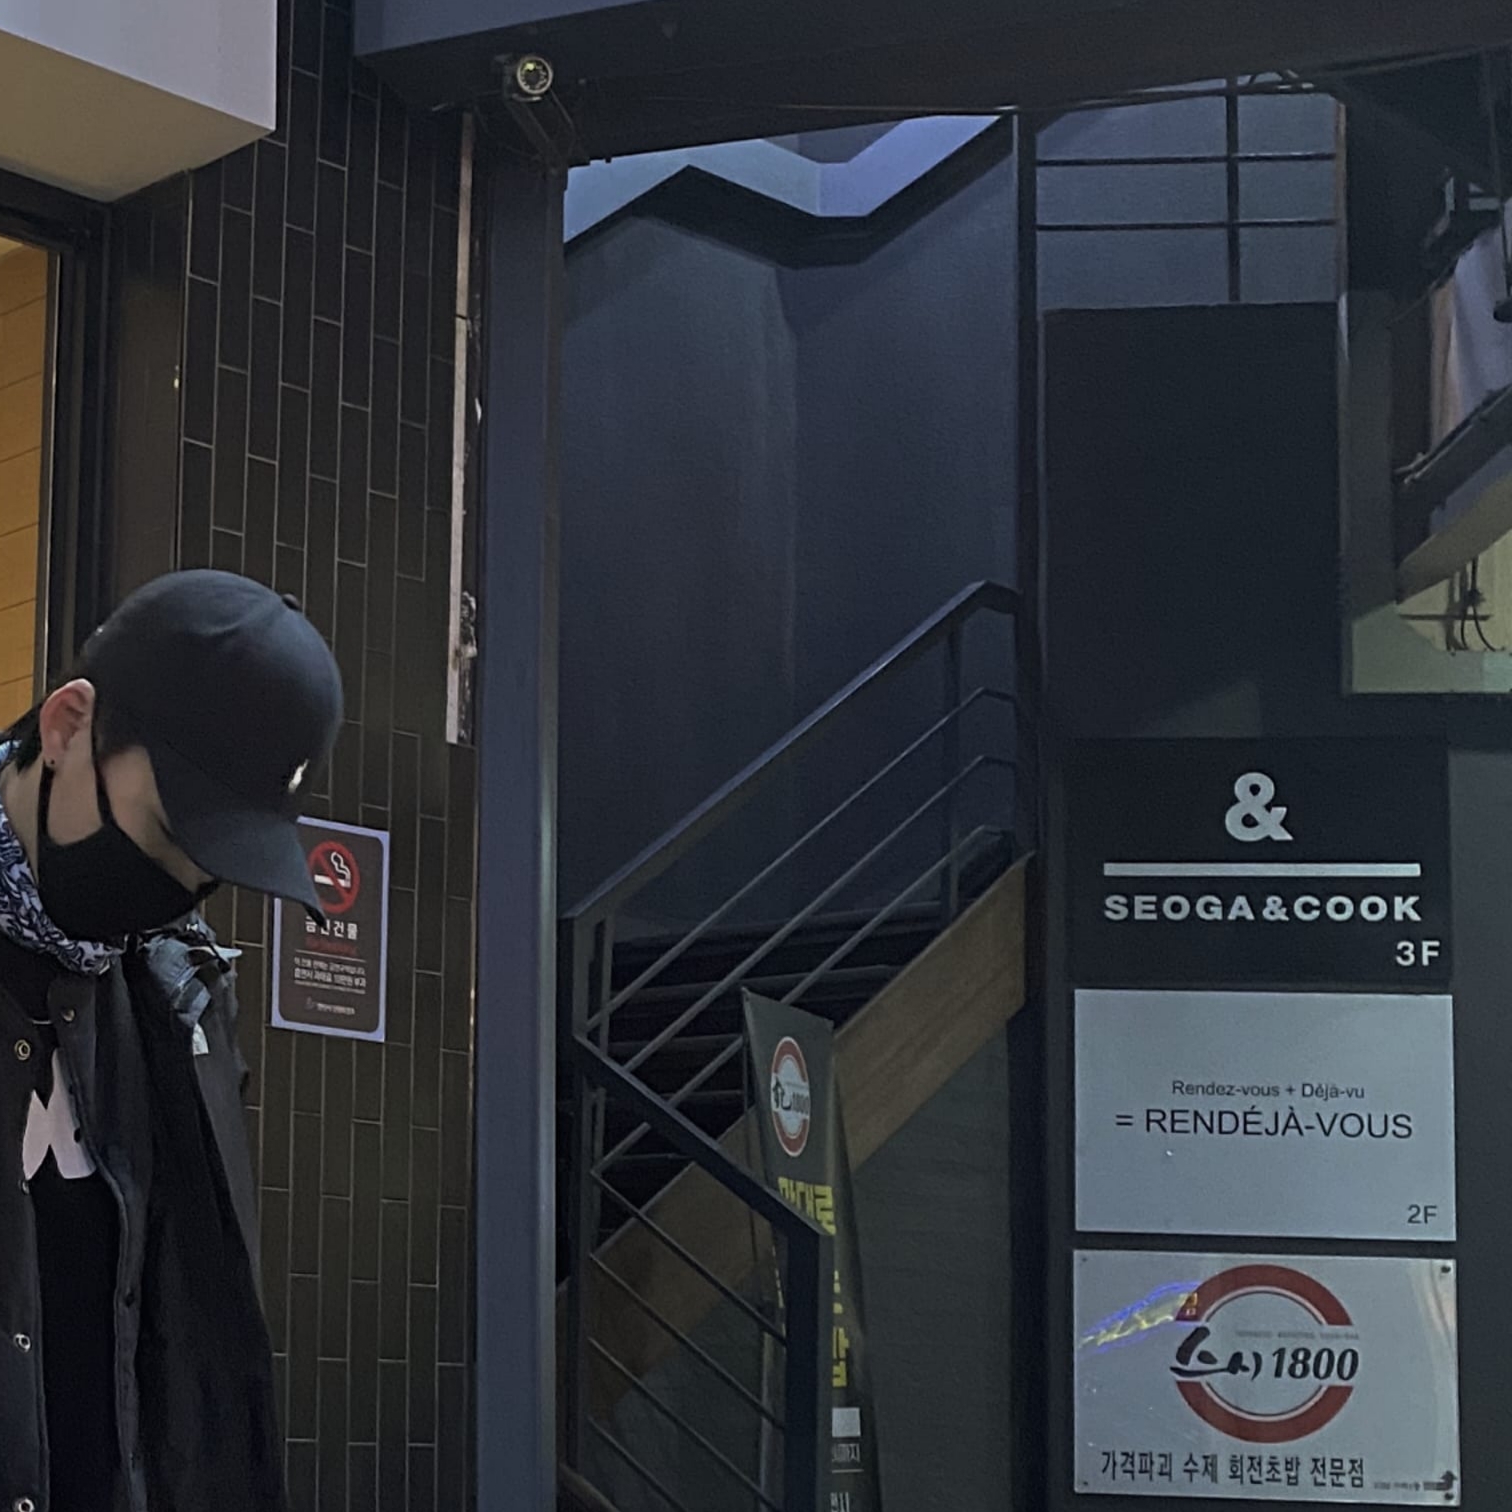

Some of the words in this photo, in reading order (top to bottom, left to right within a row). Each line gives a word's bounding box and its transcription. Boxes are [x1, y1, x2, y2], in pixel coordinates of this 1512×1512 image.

[1103, 894, 1423, 922] SEOGA&COOK
[1395, 941, 1440, 966] 3F
[1172, 1080, 1280, 1099] Rendez-vous
[1301, 1082, 1365, 1102] Déjà-vu
[1145, 1104, 1413, 1140] RENDÉJÀ-VOUS
[1407, 1204, 1438, 1225] 2F
[1272, 1346, 1360, 1381] 1800
[1101, 1450, 1173, 1483] 가격파괴
[1183, 1453, 1219, 1485] 수제
[1228, 1455, 1301, 1488] 회전초밥
[1310, 1458, 1365, 1489] 전문점
